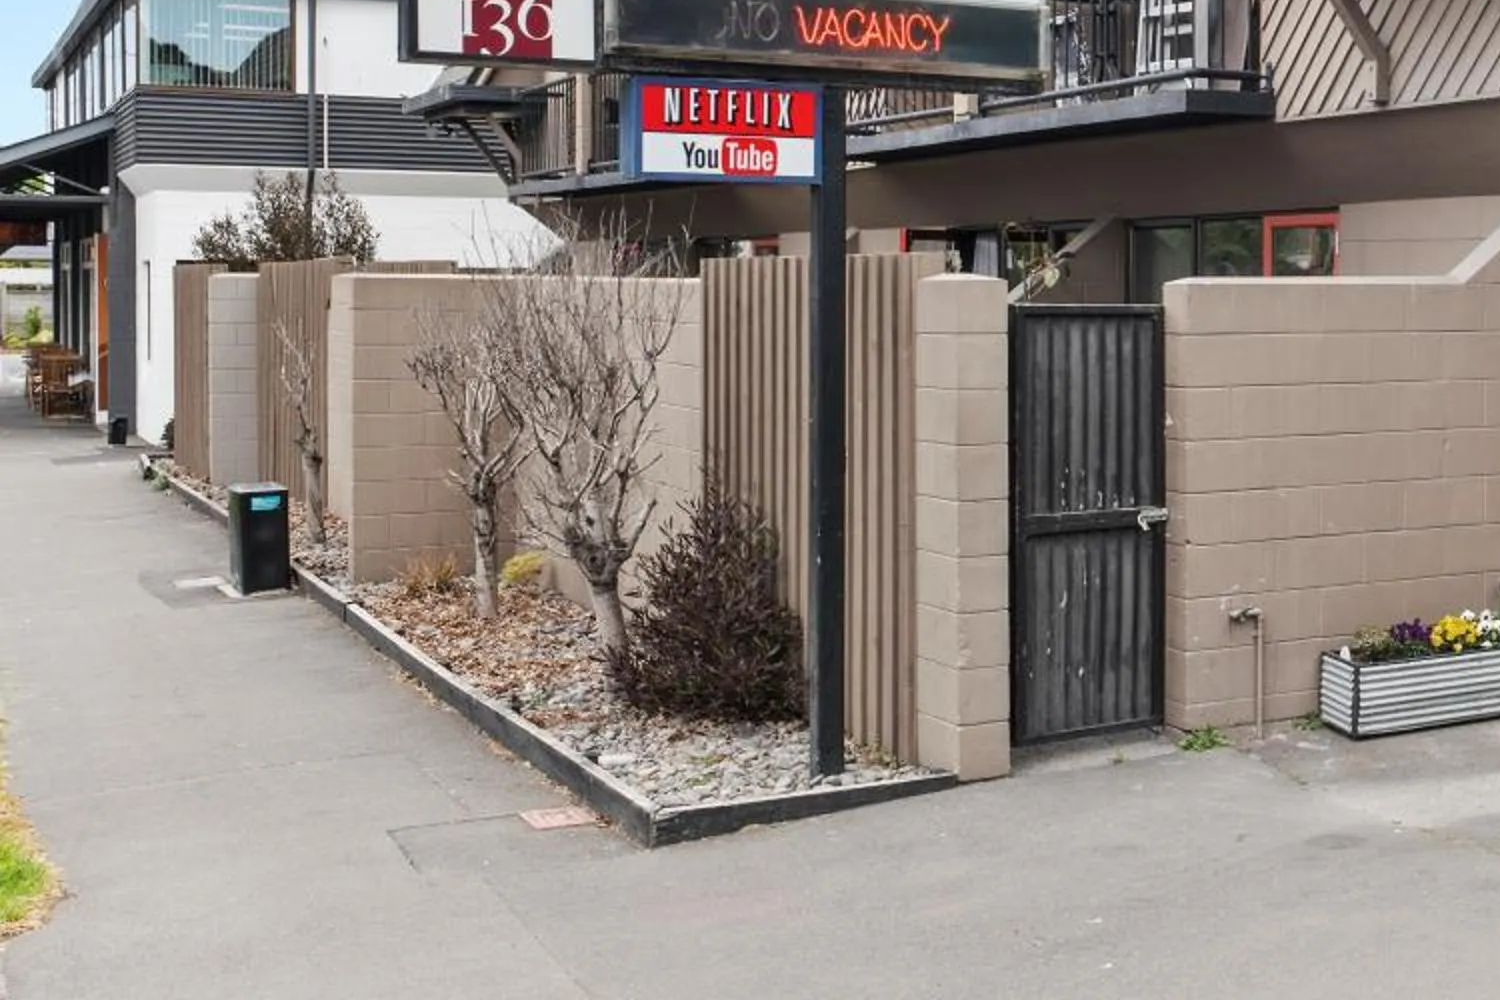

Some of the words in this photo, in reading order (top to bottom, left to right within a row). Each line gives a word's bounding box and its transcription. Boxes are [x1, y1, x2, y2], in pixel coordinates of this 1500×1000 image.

[727, 0, 780, 42] NO
[796, 6, 950, 52] VACANCY
[664, 87, 792, 129] NETFLIX
